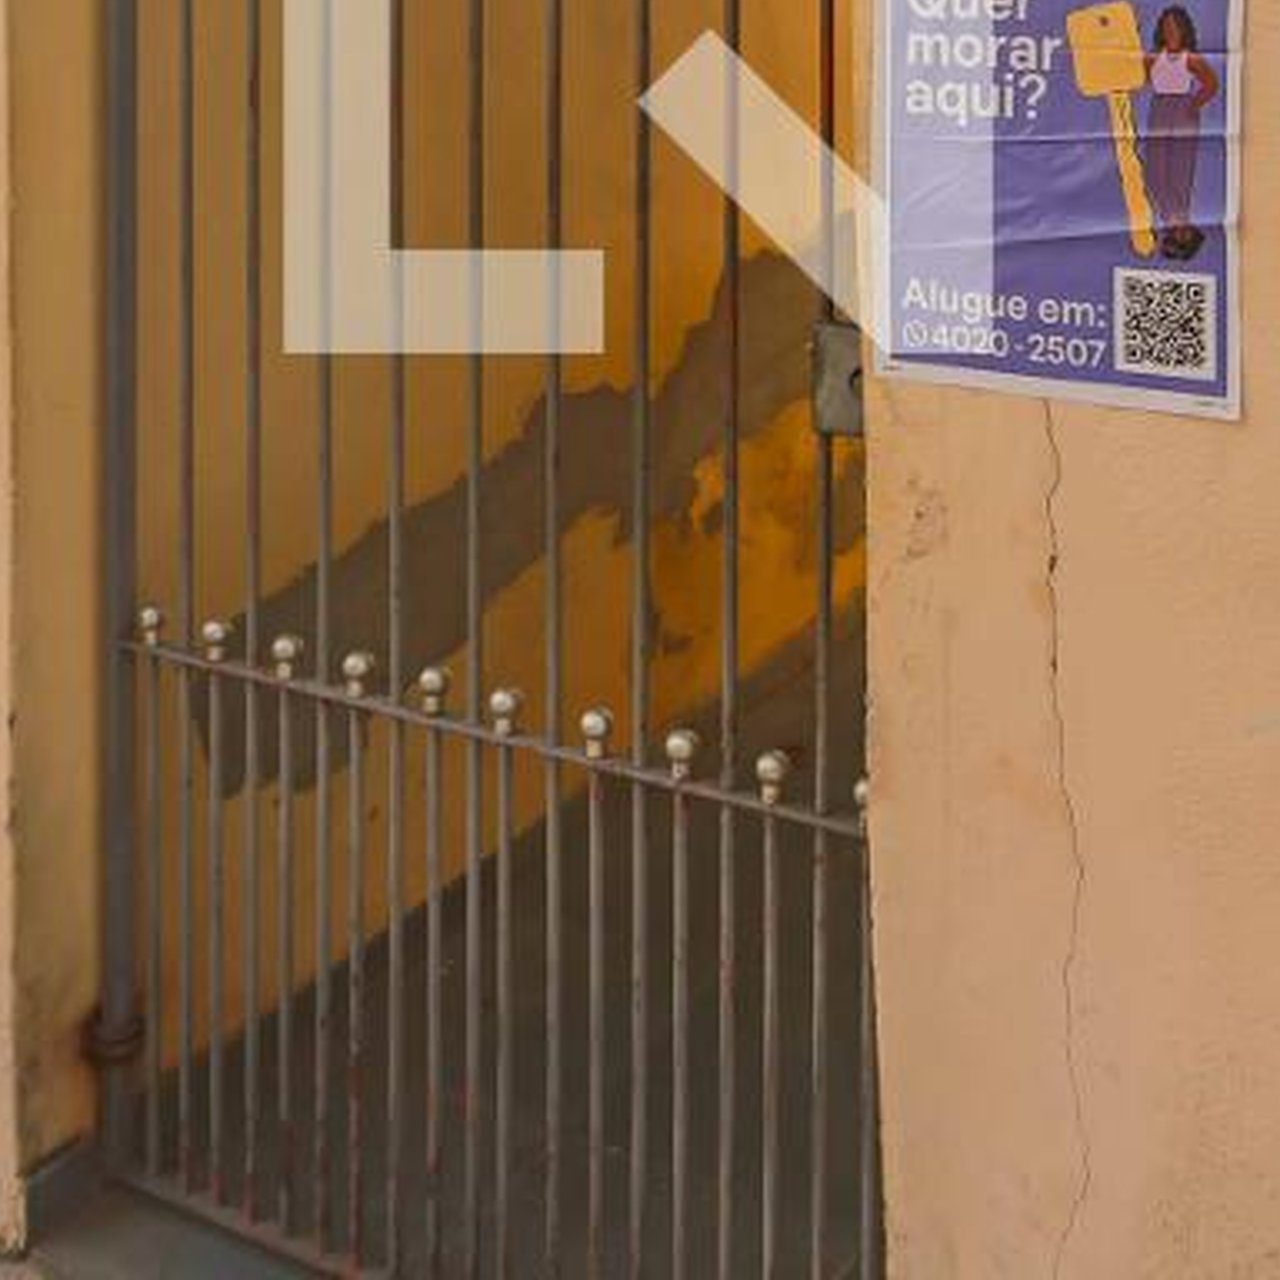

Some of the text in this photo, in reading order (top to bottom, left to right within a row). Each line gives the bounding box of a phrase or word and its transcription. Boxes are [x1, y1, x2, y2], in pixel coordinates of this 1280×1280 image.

[906, 28, 1062, 72] morar
[905, 74, 1048, 126] aqui?
[902, 278, 1107, 328] Alugue em:
